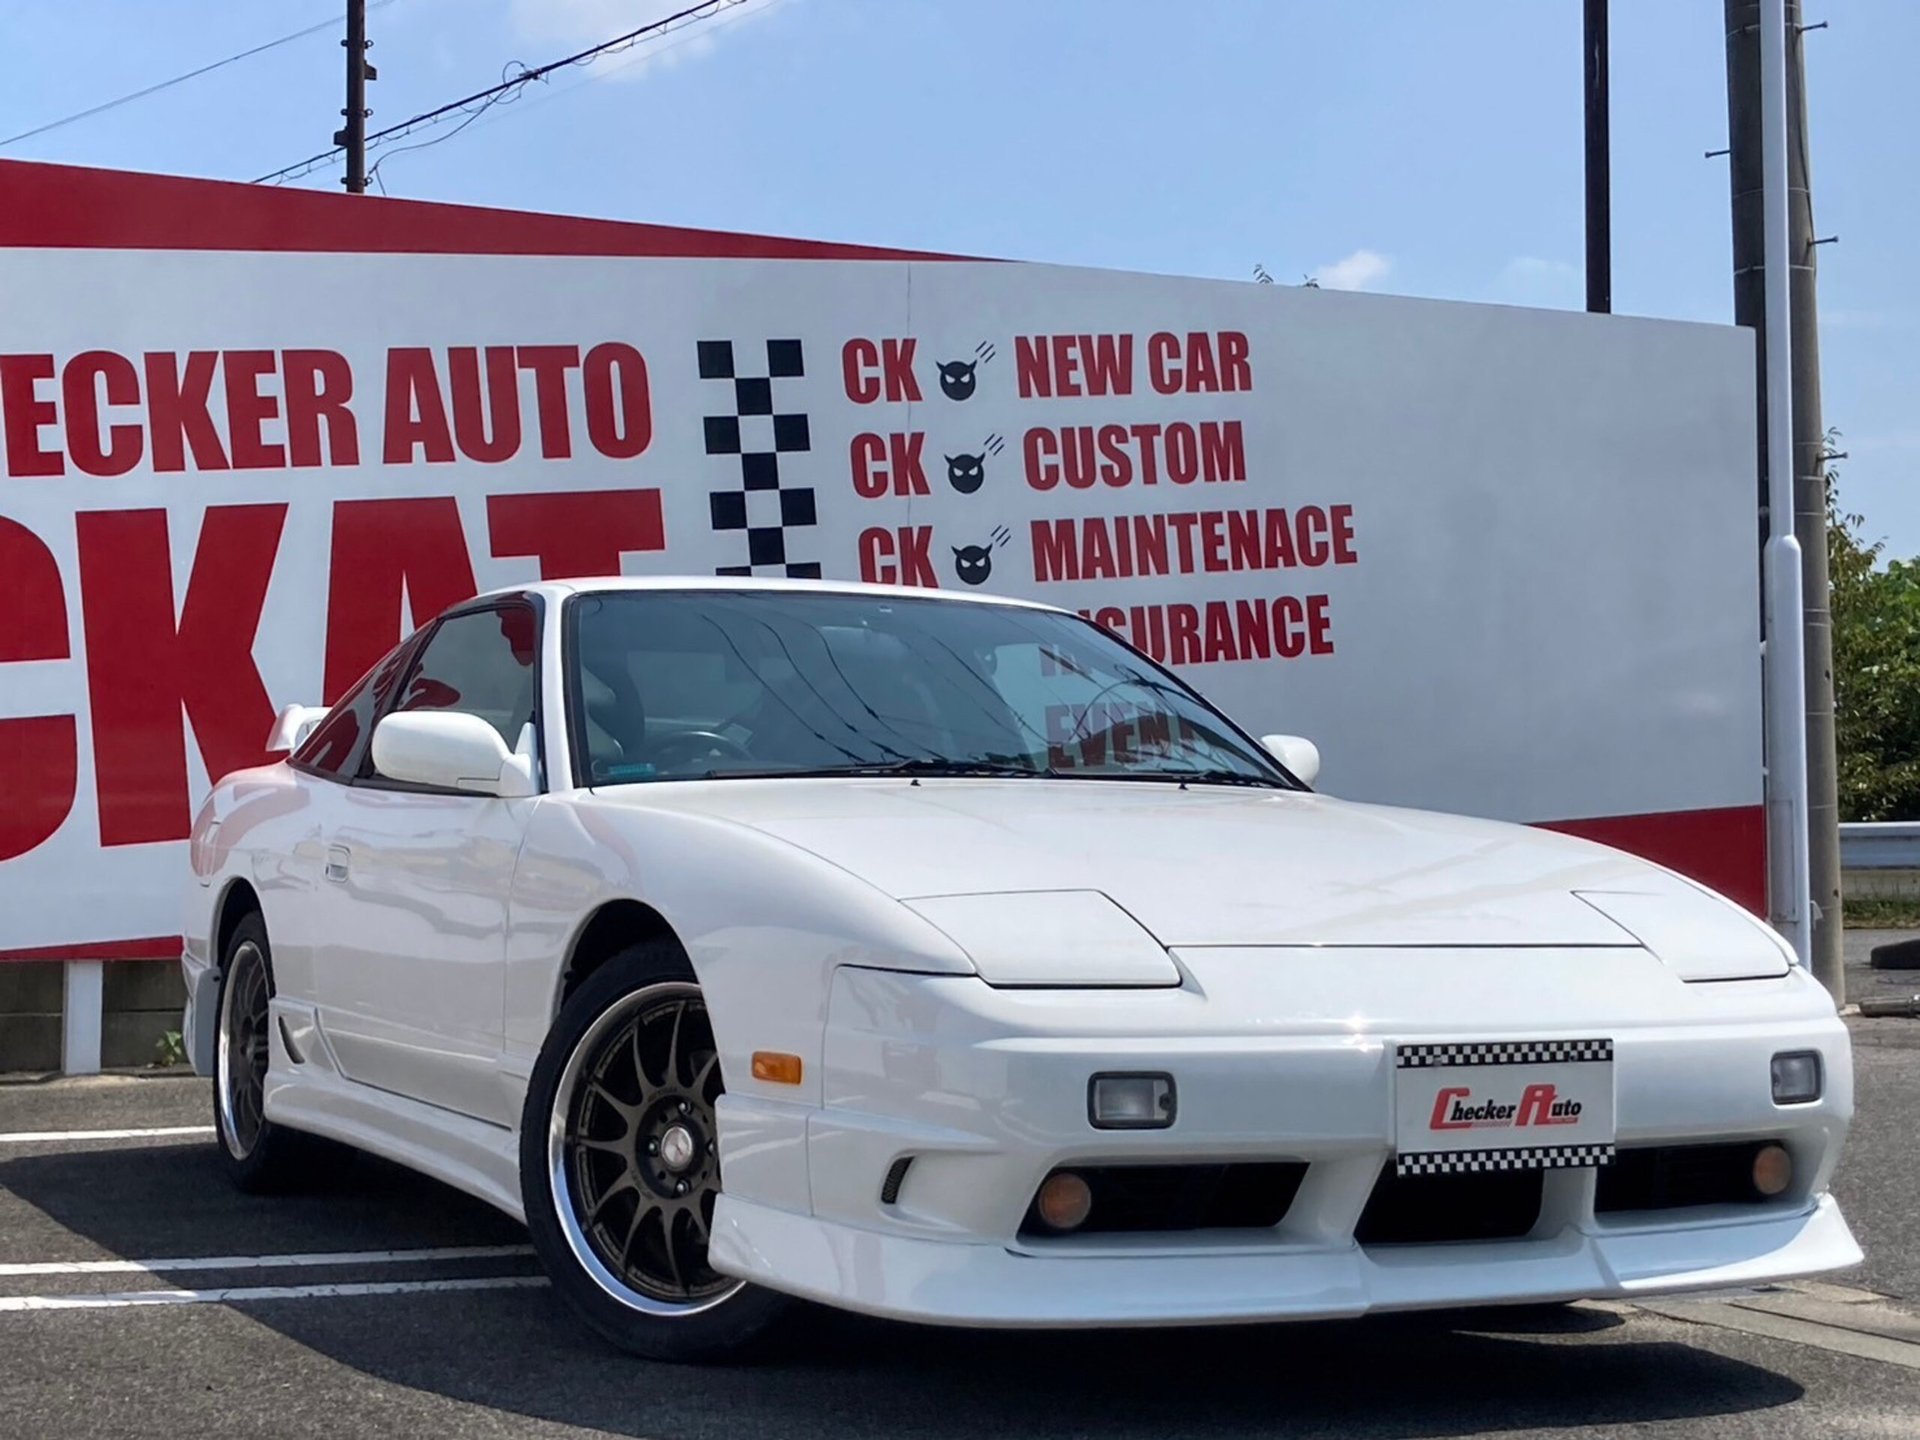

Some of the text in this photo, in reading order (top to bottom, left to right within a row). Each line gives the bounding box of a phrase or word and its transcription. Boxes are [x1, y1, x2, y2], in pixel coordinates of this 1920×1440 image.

[842, 331, 1253, 404] CK NEW CAR
[0, 342, 654, 477] ECKER AUTO
[850, 421, 1246, 499] CK CUSTOM
[858, 504, 1358, 589] CK MAINTENACE
[1429, 1083, 1583, 1131] Checker Auto
